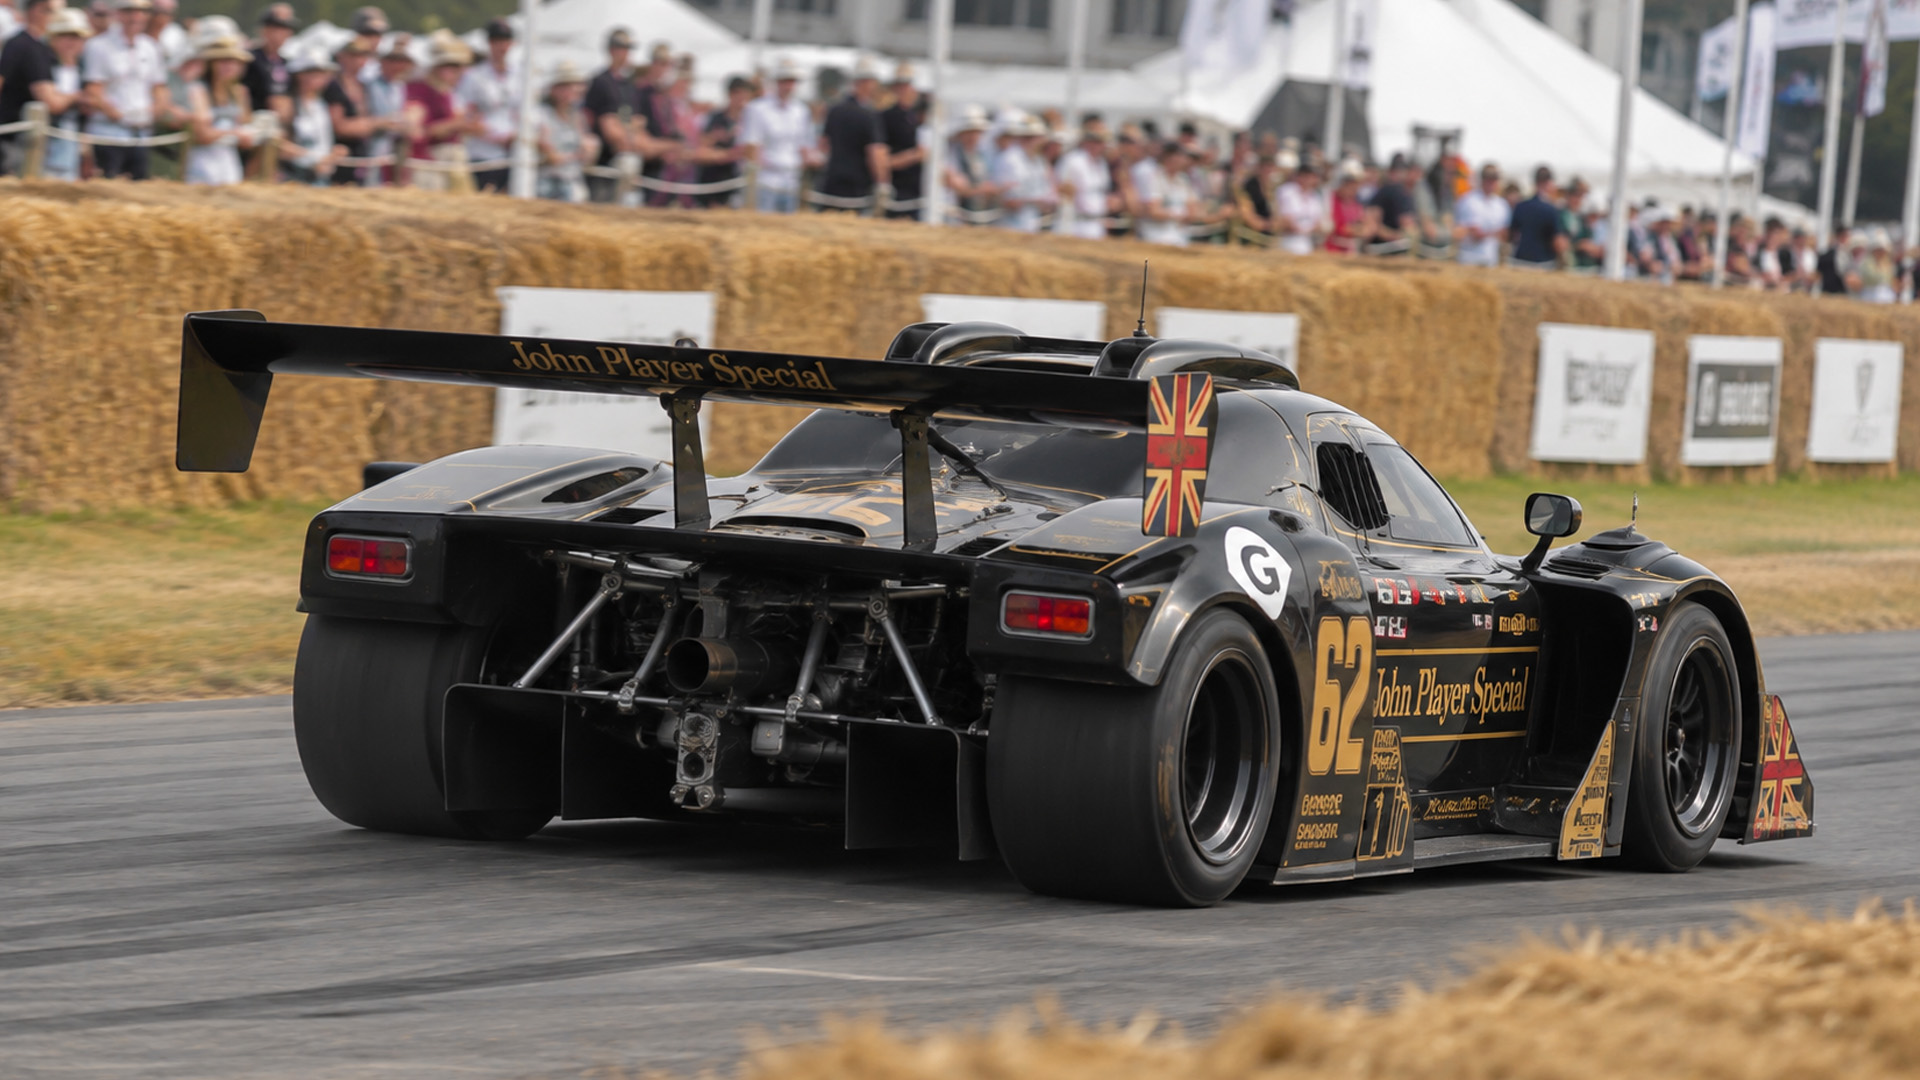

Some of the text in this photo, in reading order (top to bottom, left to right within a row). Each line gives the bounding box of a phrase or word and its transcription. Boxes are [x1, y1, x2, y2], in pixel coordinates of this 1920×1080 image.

[509, 340, 838, 391] John Player Special
[1241, 545, 1281, 596] G
[1308, 616, 1373, 775] 62
[1373, 666, 1529, 726] John Player Special
